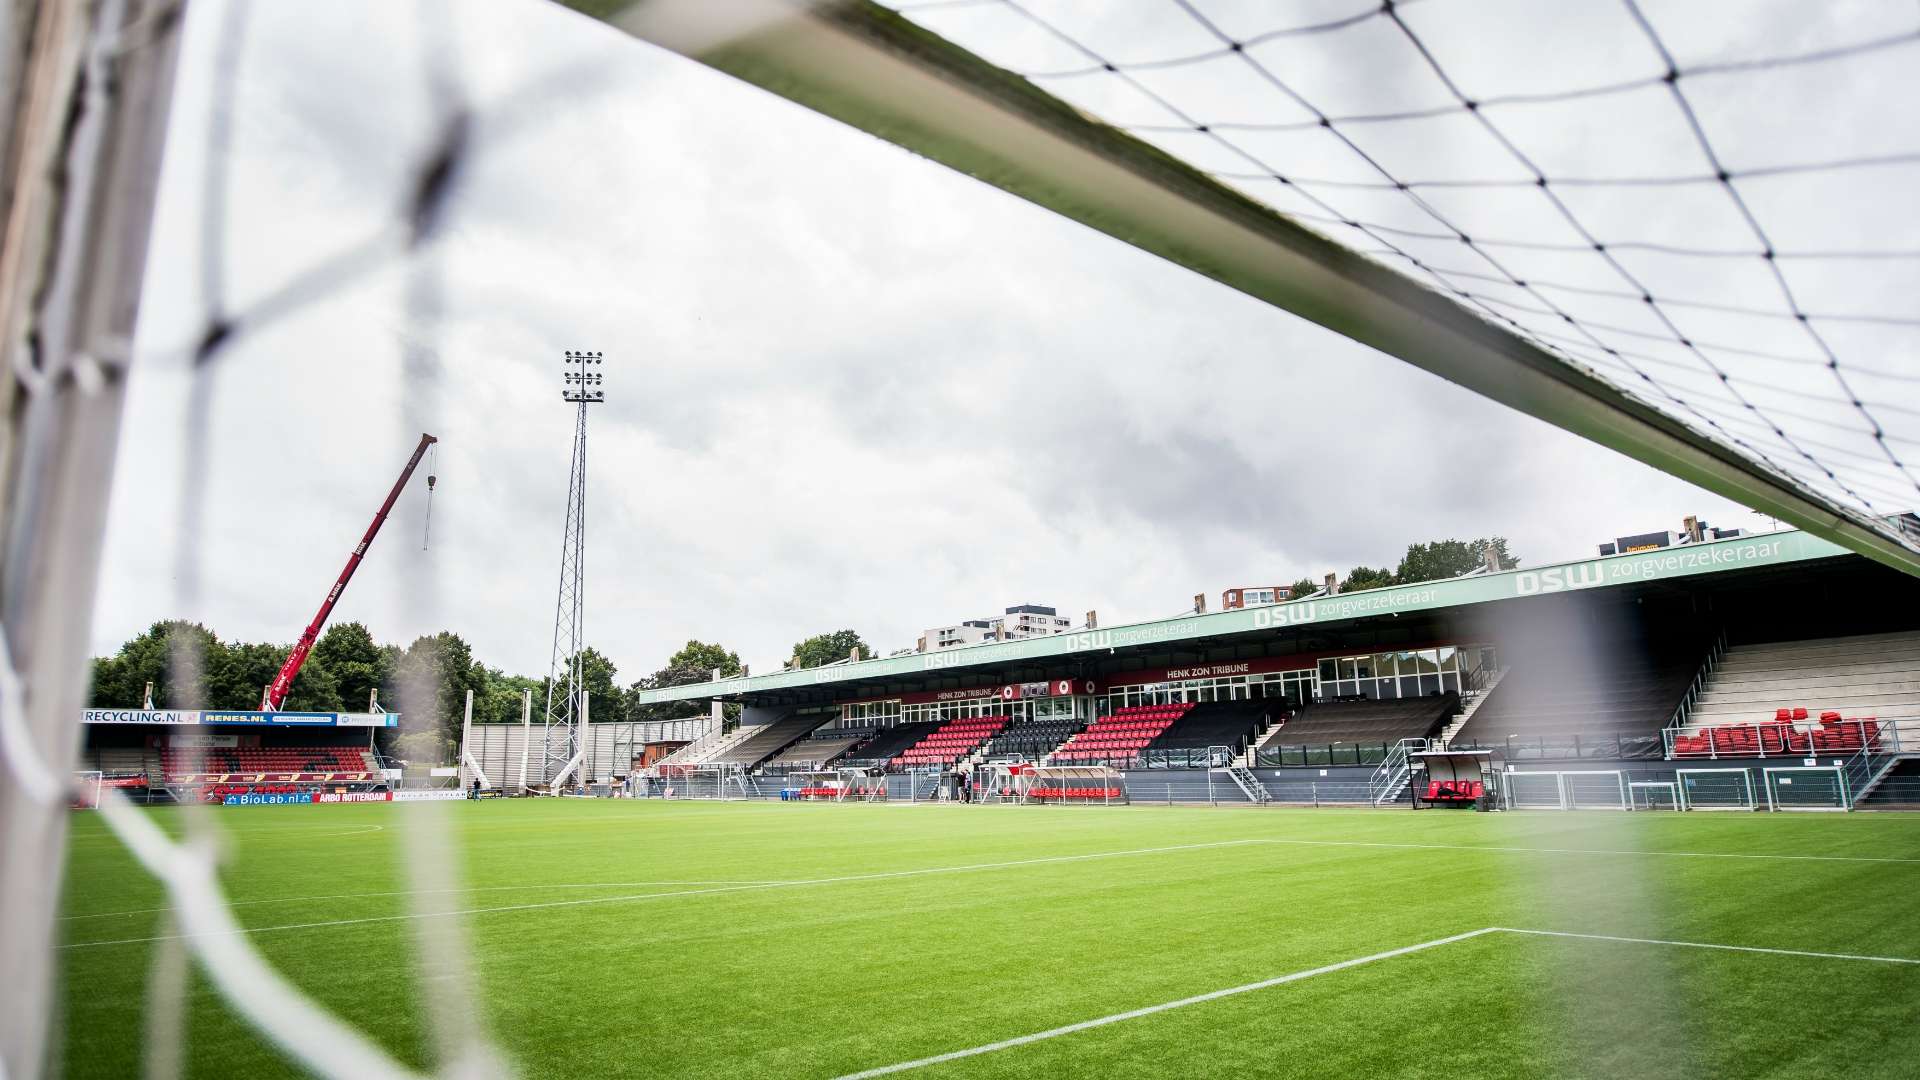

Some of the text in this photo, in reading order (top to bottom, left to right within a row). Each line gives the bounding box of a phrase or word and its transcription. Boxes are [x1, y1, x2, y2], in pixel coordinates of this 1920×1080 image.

[1516, 540, 1782, 595] DSW zorgverzekeraar
[1254, 589, 1438, 628] DSW zorgverzekeraar
[1066, 622, 1199, 652] DSW zorgverzekeraar
[925, 652, 960, 669] DSW
[816, 667, 846, 683] DSW
[1168, 663, 1249, 679] HENK ZON TRIBUNE
[938, 688, 991, 700] HENK ZON TRIBUNE
[241, 794, 299, 805] BioLab.nl
[320, 792, 387, 802] ARBO ROTTERDAM
